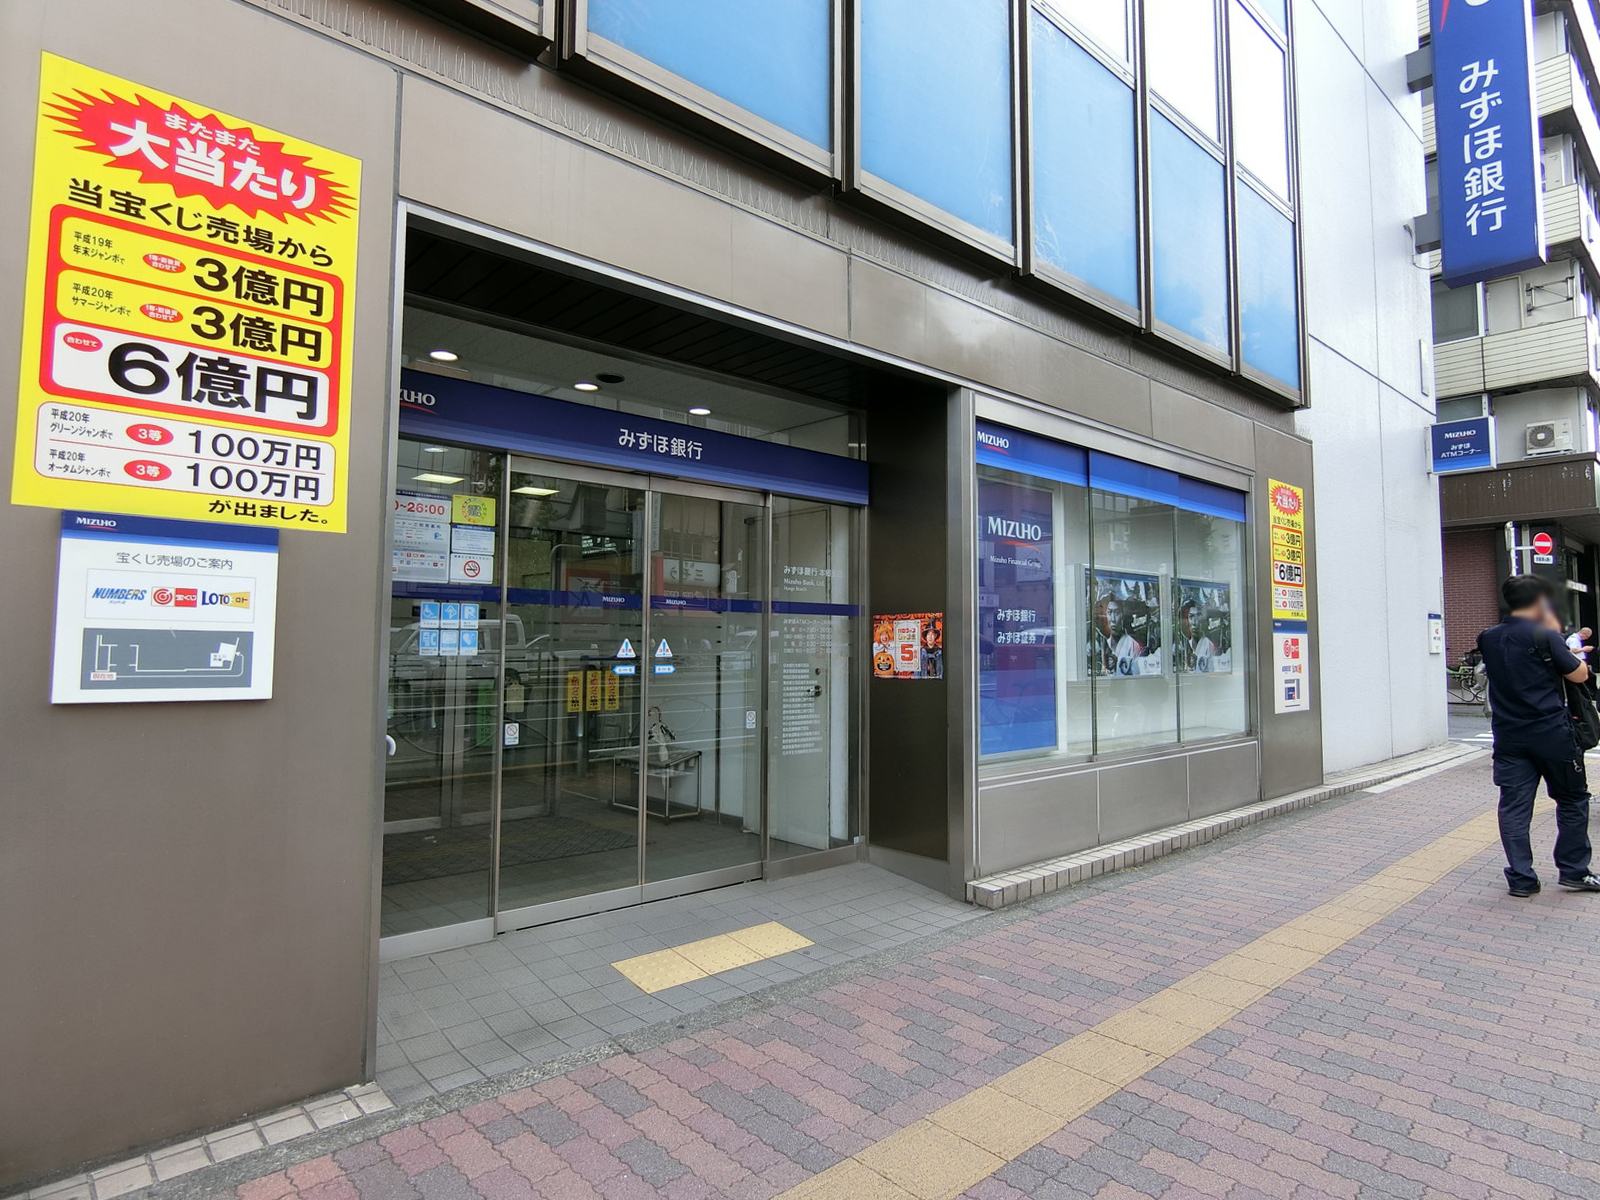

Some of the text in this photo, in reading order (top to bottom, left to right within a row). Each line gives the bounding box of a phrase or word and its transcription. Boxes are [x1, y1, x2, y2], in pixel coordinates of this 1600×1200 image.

[164, 113, 261, 156] またまた
[1459, 58, 1507, 236] みずほ銀行
[109, 119, 316, 210] 大当たり
[68, 177, 333, 267] 当宝くじ売場から
[74, 231, 113, 248] 平成19年
[73, 244, 125, 265] 年末ジャンボで
[72, 282, 113, 299] 平成20年
[193, 257, 325, 317] 3億円
[72, 296, 131, 316] サマージャンボで
[67, 336, 98, 348] 合わせて
[190, 306, 322, 362] 3億円
[107, 341, 319, 421] 6億円
[51, 408, 90, 424] 平成20年
[50, 422, 113, 440] グリーンジャンボで
[138, 428, 163, 442] 3等
[1444, 430, 1477, 439] MIZUHO
[618, 428, 703, 460] みずほ銀行
[977, 431, 1010, 449] MIZUHO
[49, 449, 86, 462] 平成20年
[188, 429, 321, 471] 100万円
[1440, 449, 1481, 458] ATMコーナー
[48, 463, 111, 478] オータムジャンボで
[136, 465, 160, 478] 3等
[186, 462, 320, 501] 100万円
[209, 500, 328, 525] が出ました。
[76, 516, 117, 527] MIZUHO
[988, 516, 1041, 541] MIZUHO
[116, 552, 233, 570] 宝くじ売場のご案内
[989, 555, 1008, 564] Mizuho
[1008, 557, 1027, 566] Financial
[783, 565, 818, 577] みずほ銀行
[1279, 563, 1302, 583] 6億円
[92, 587, 147, 601] NUMBERS
[201, 590, 230, 606] LOTO
[602, 595, 625, 603] MIZUHO
[997, 609, 1036, 623] みずほ銀行
[997, 631, 1036, 644] みずほ証券
